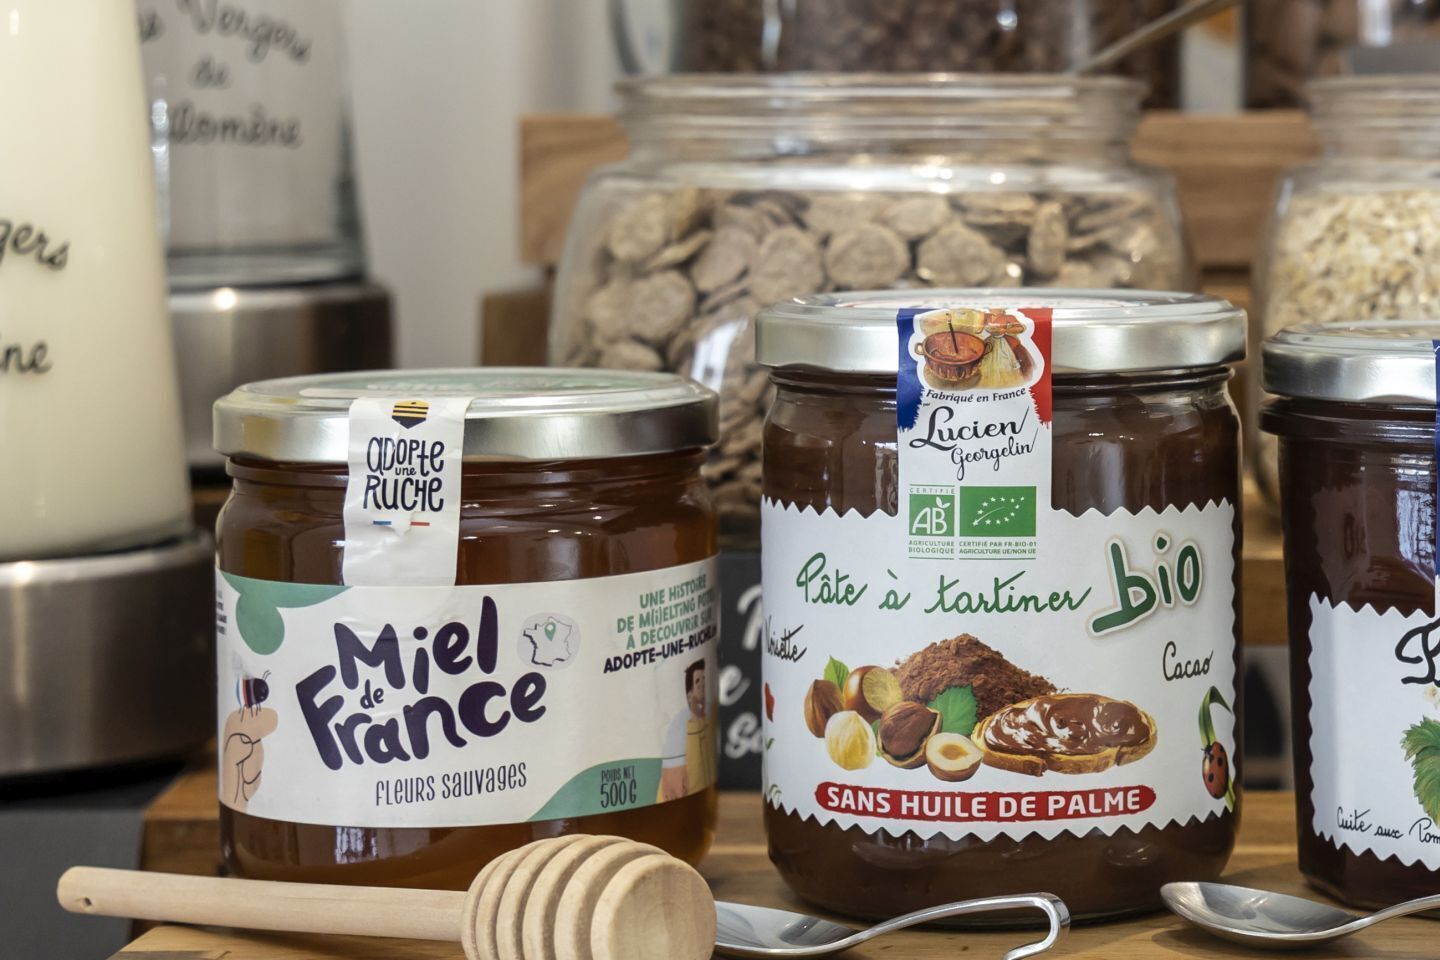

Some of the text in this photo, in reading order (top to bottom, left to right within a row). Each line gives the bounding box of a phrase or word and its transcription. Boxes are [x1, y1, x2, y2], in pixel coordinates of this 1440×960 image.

[926, 389, 974, 404] Fabriqué
[993, 387, 1026, 401] France
[909, 405, 1029, 451] Lucien
[951, 427, 1038, 481] Georgelin
[395, 466, 417, 477] une
[911, 507, 947, 534] AB
[908, 547, 954, 555] BIOLOGIQUE
[640, 589, 665, 609] UNE
[796, 552, 1092, 614] Pâte à tartiner
[1091, 535, 1202, 634] bio
[617, 616, 634, 634] DE
[700, 607, 712, 627] SUR
[333, 595, 499, 695] Miel
[765, 615, 807, 662] Noisette
[1163, 641, 1214, 681] Cacao
[359, 679, 384, 709] de
[295, 664, 547, 771] France
[601, 780, 627, 808] 500
[827, 786, 1140, 818] SANS HUILE DE PALME
[1337, 806, 1372, 832] Cuite
[1374, 825, 1404, 839] aux
